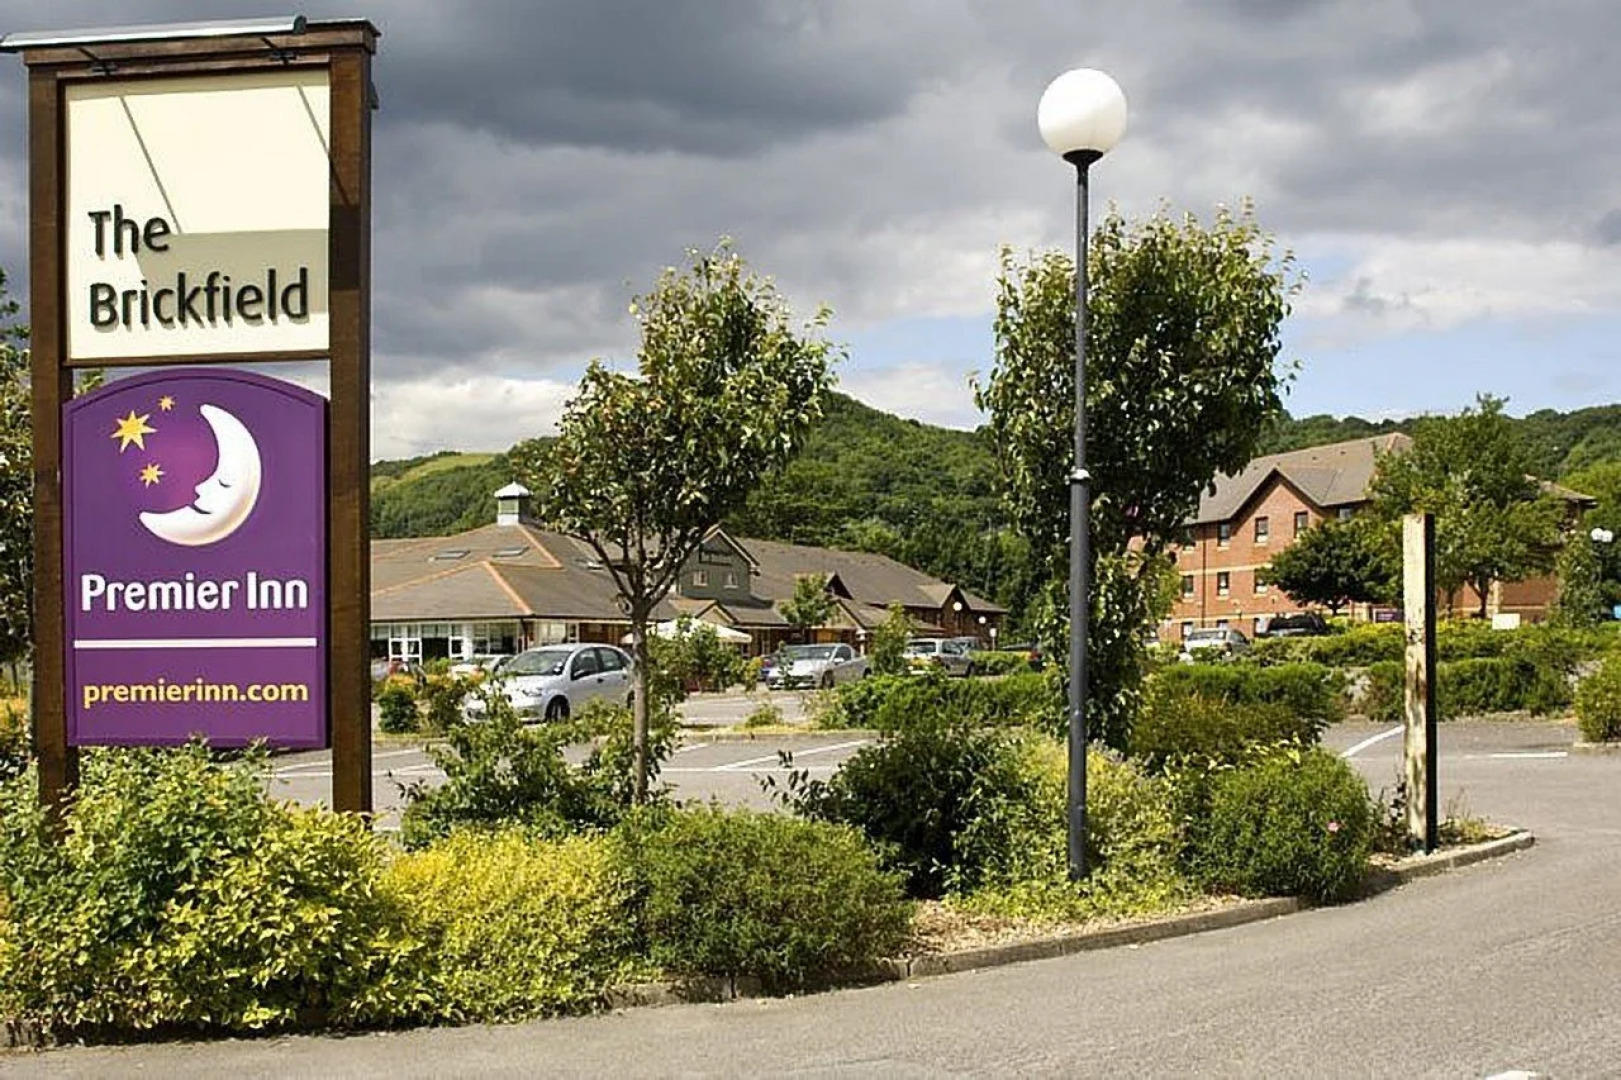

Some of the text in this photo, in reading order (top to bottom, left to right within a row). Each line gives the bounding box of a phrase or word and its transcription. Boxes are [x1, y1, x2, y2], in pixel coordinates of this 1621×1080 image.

[88, 204, 170, 256] The
[90, 267, 309, 328] Brickfield
[81, 571, 308, 612] Premier Inn
[83, 677, 308, 710] premierinn.com
